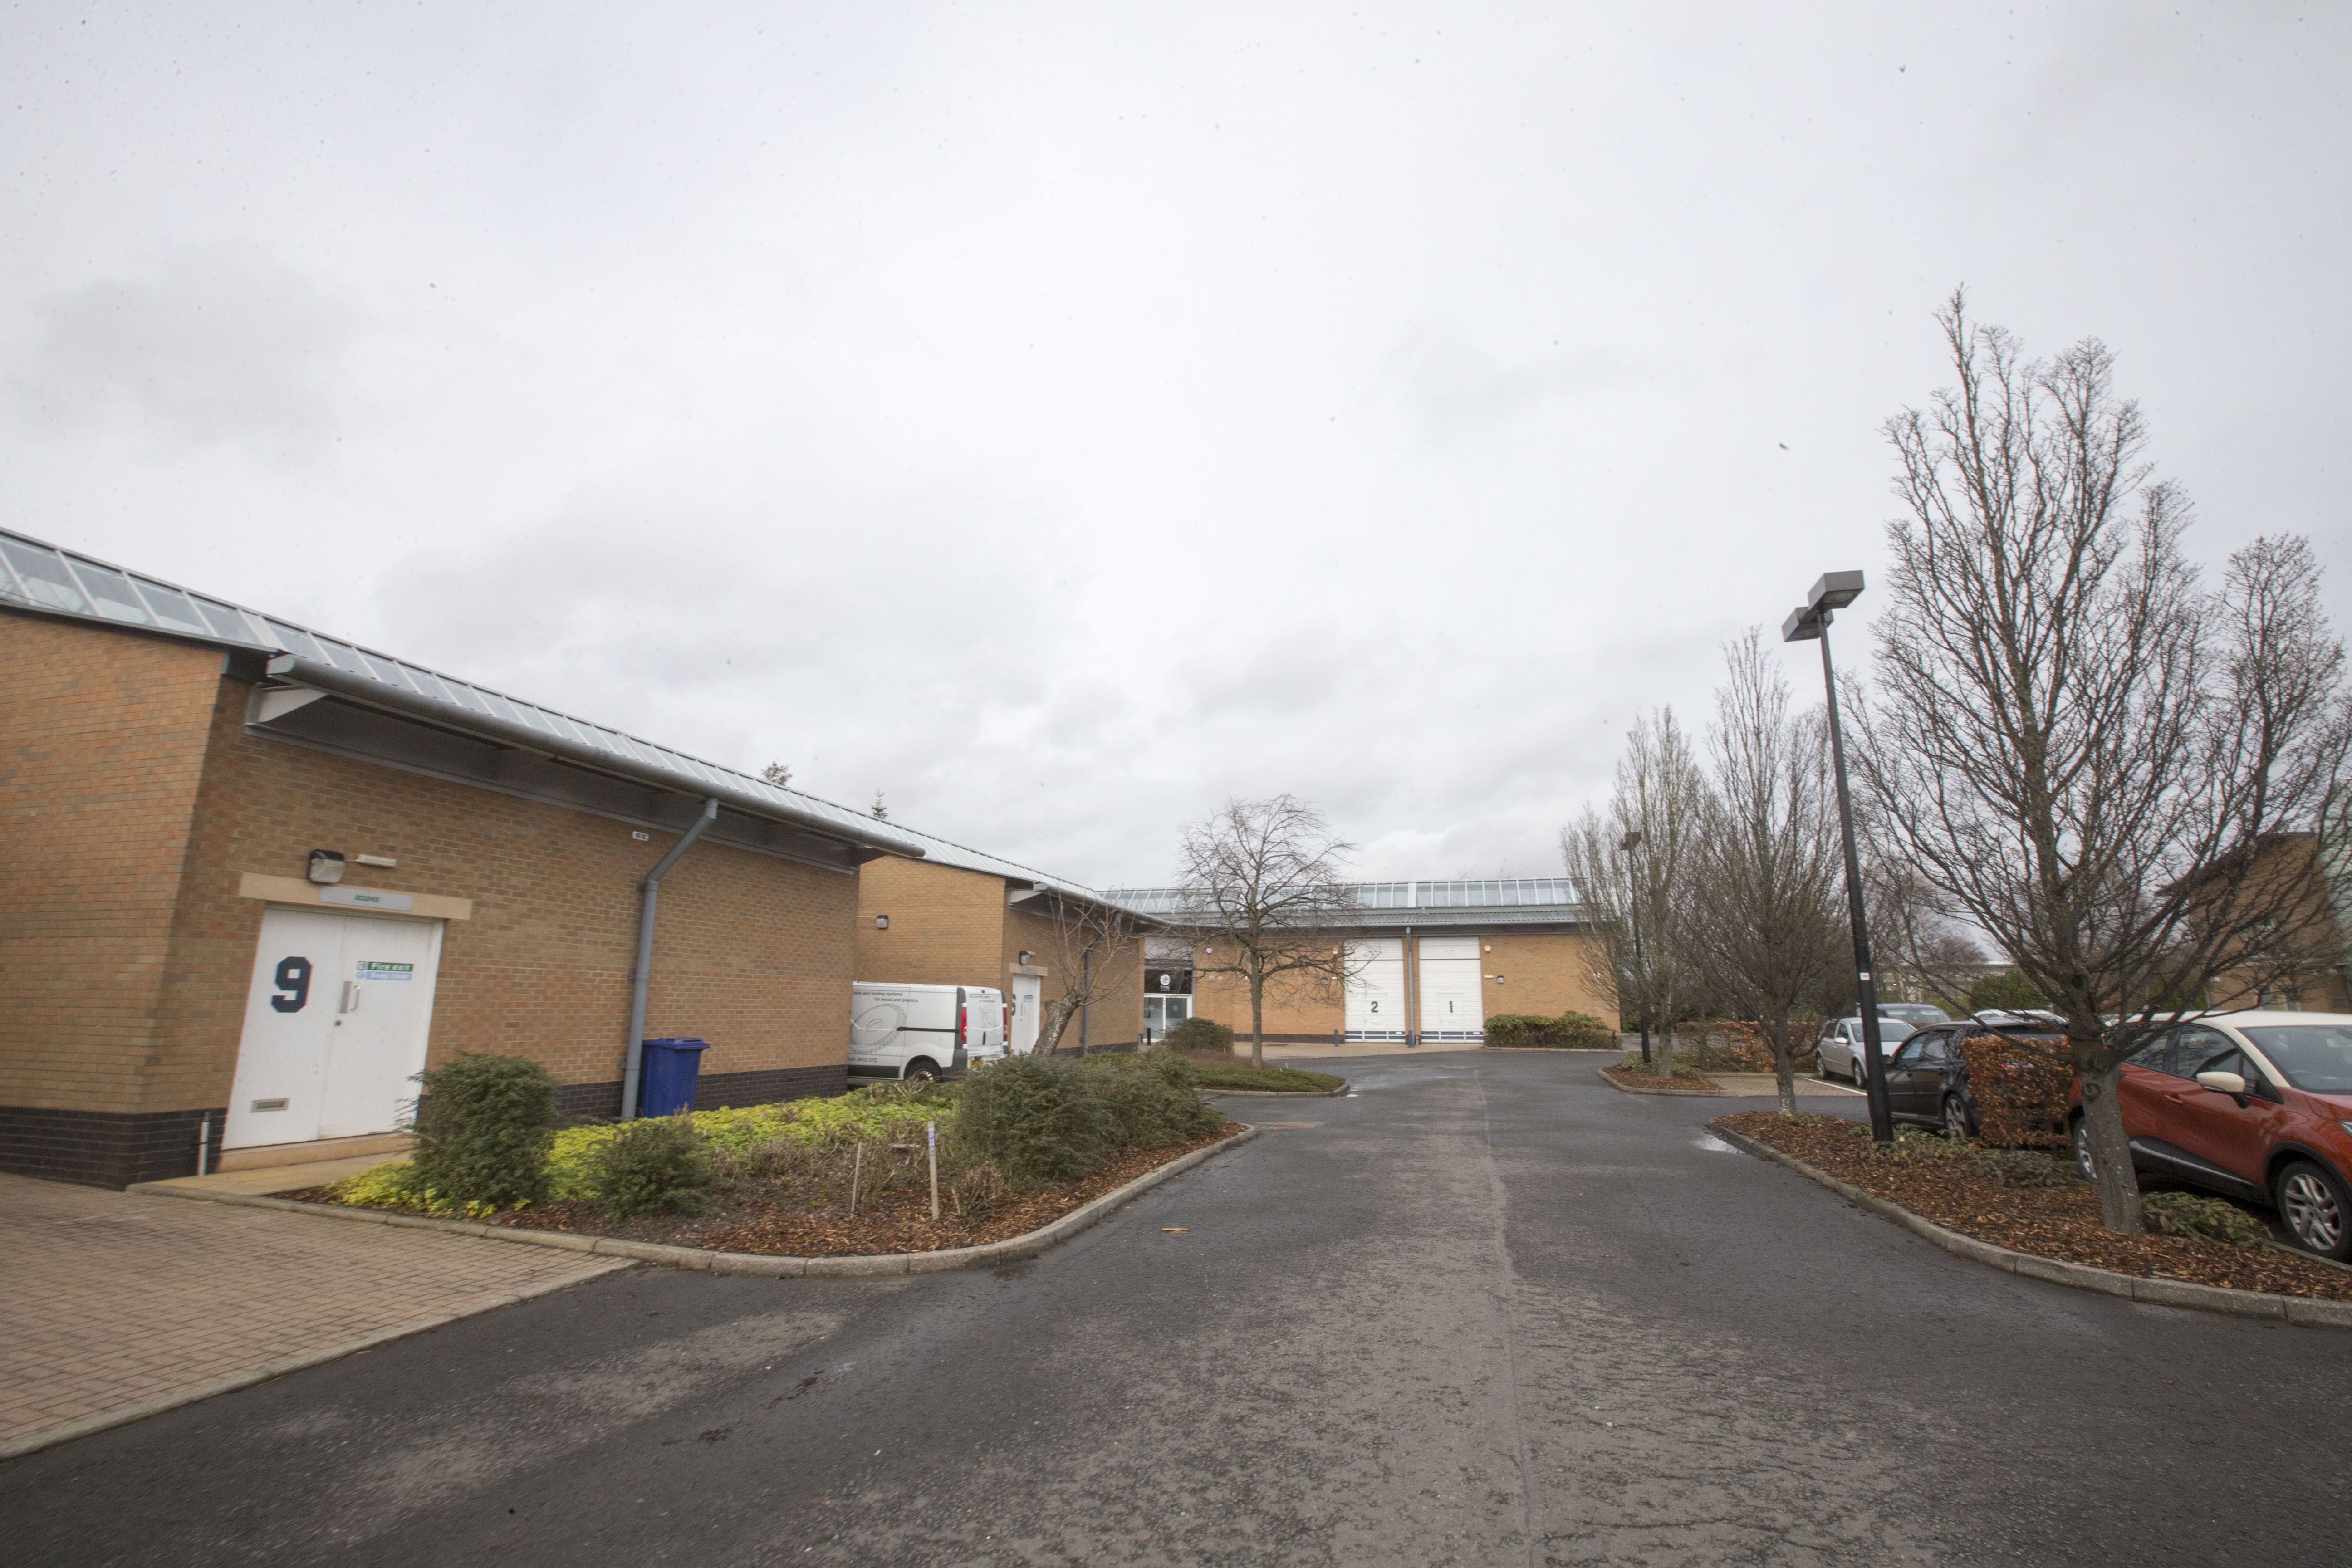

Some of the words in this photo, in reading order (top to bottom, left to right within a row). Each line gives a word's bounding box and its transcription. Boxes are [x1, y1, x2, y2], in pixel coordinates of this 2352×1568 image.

[371, 962, 391, 970] Fire
[270, 956, 313, 1013] 9
[1371, 1001, 1378, 1013] 2
[1449, 1001, 1453, 1013] 1
